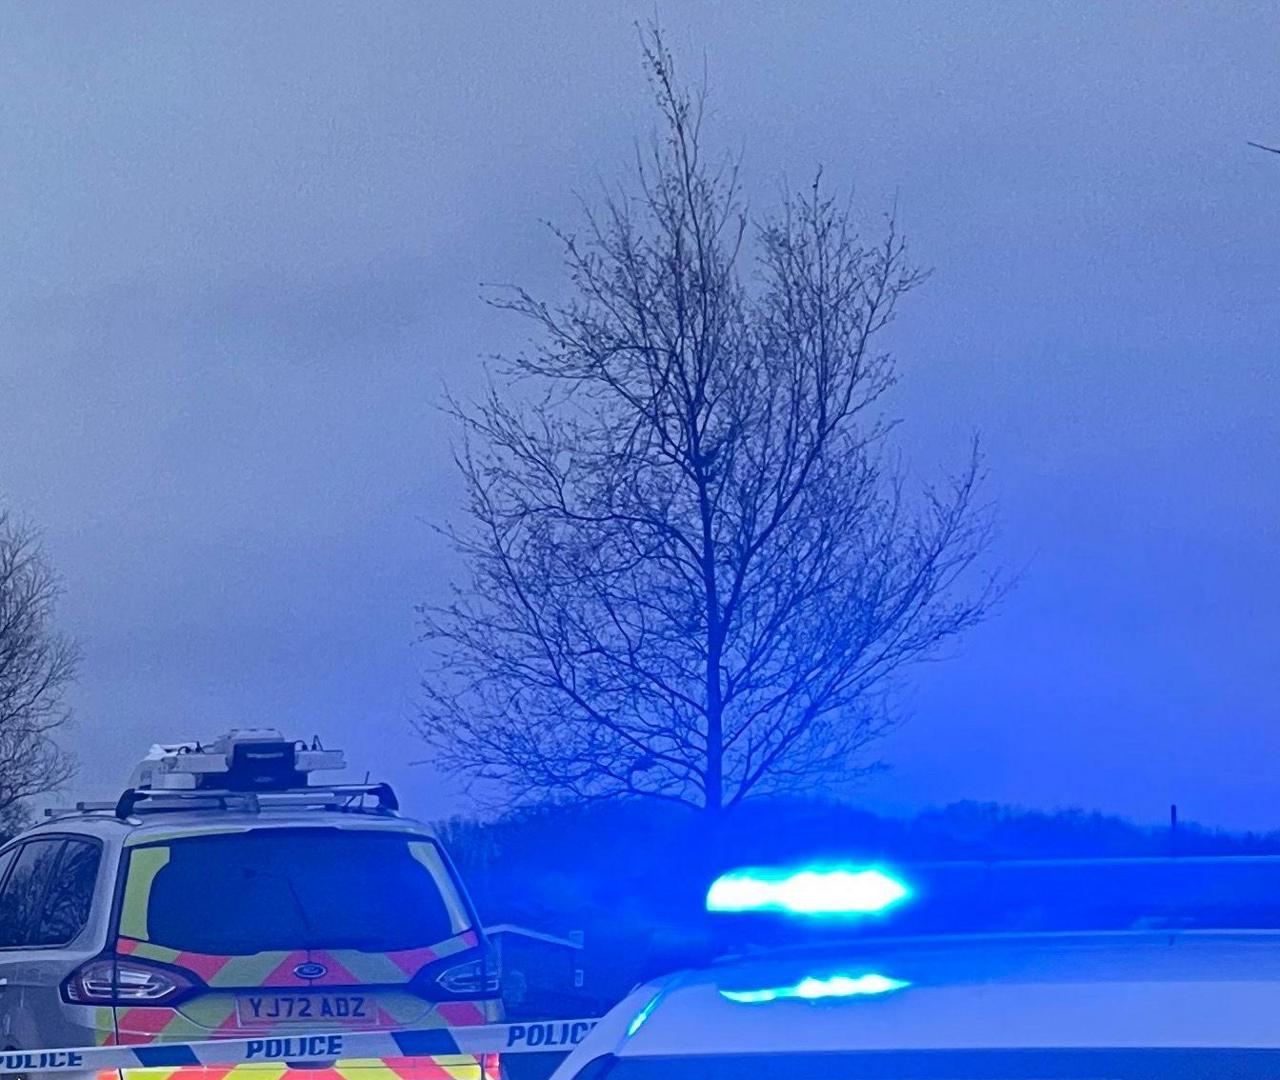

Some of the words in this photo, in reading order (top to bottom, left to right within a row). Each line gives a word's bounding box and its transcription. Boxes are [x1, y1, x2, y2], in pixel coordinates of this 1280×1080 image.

[250, 997, 312, 1018] YJ72
[320, 996, 366, 1018] ADZ
[245, 1034, 343, 1059] POLICE
[506, 1021, 598, 1048] POLIC
